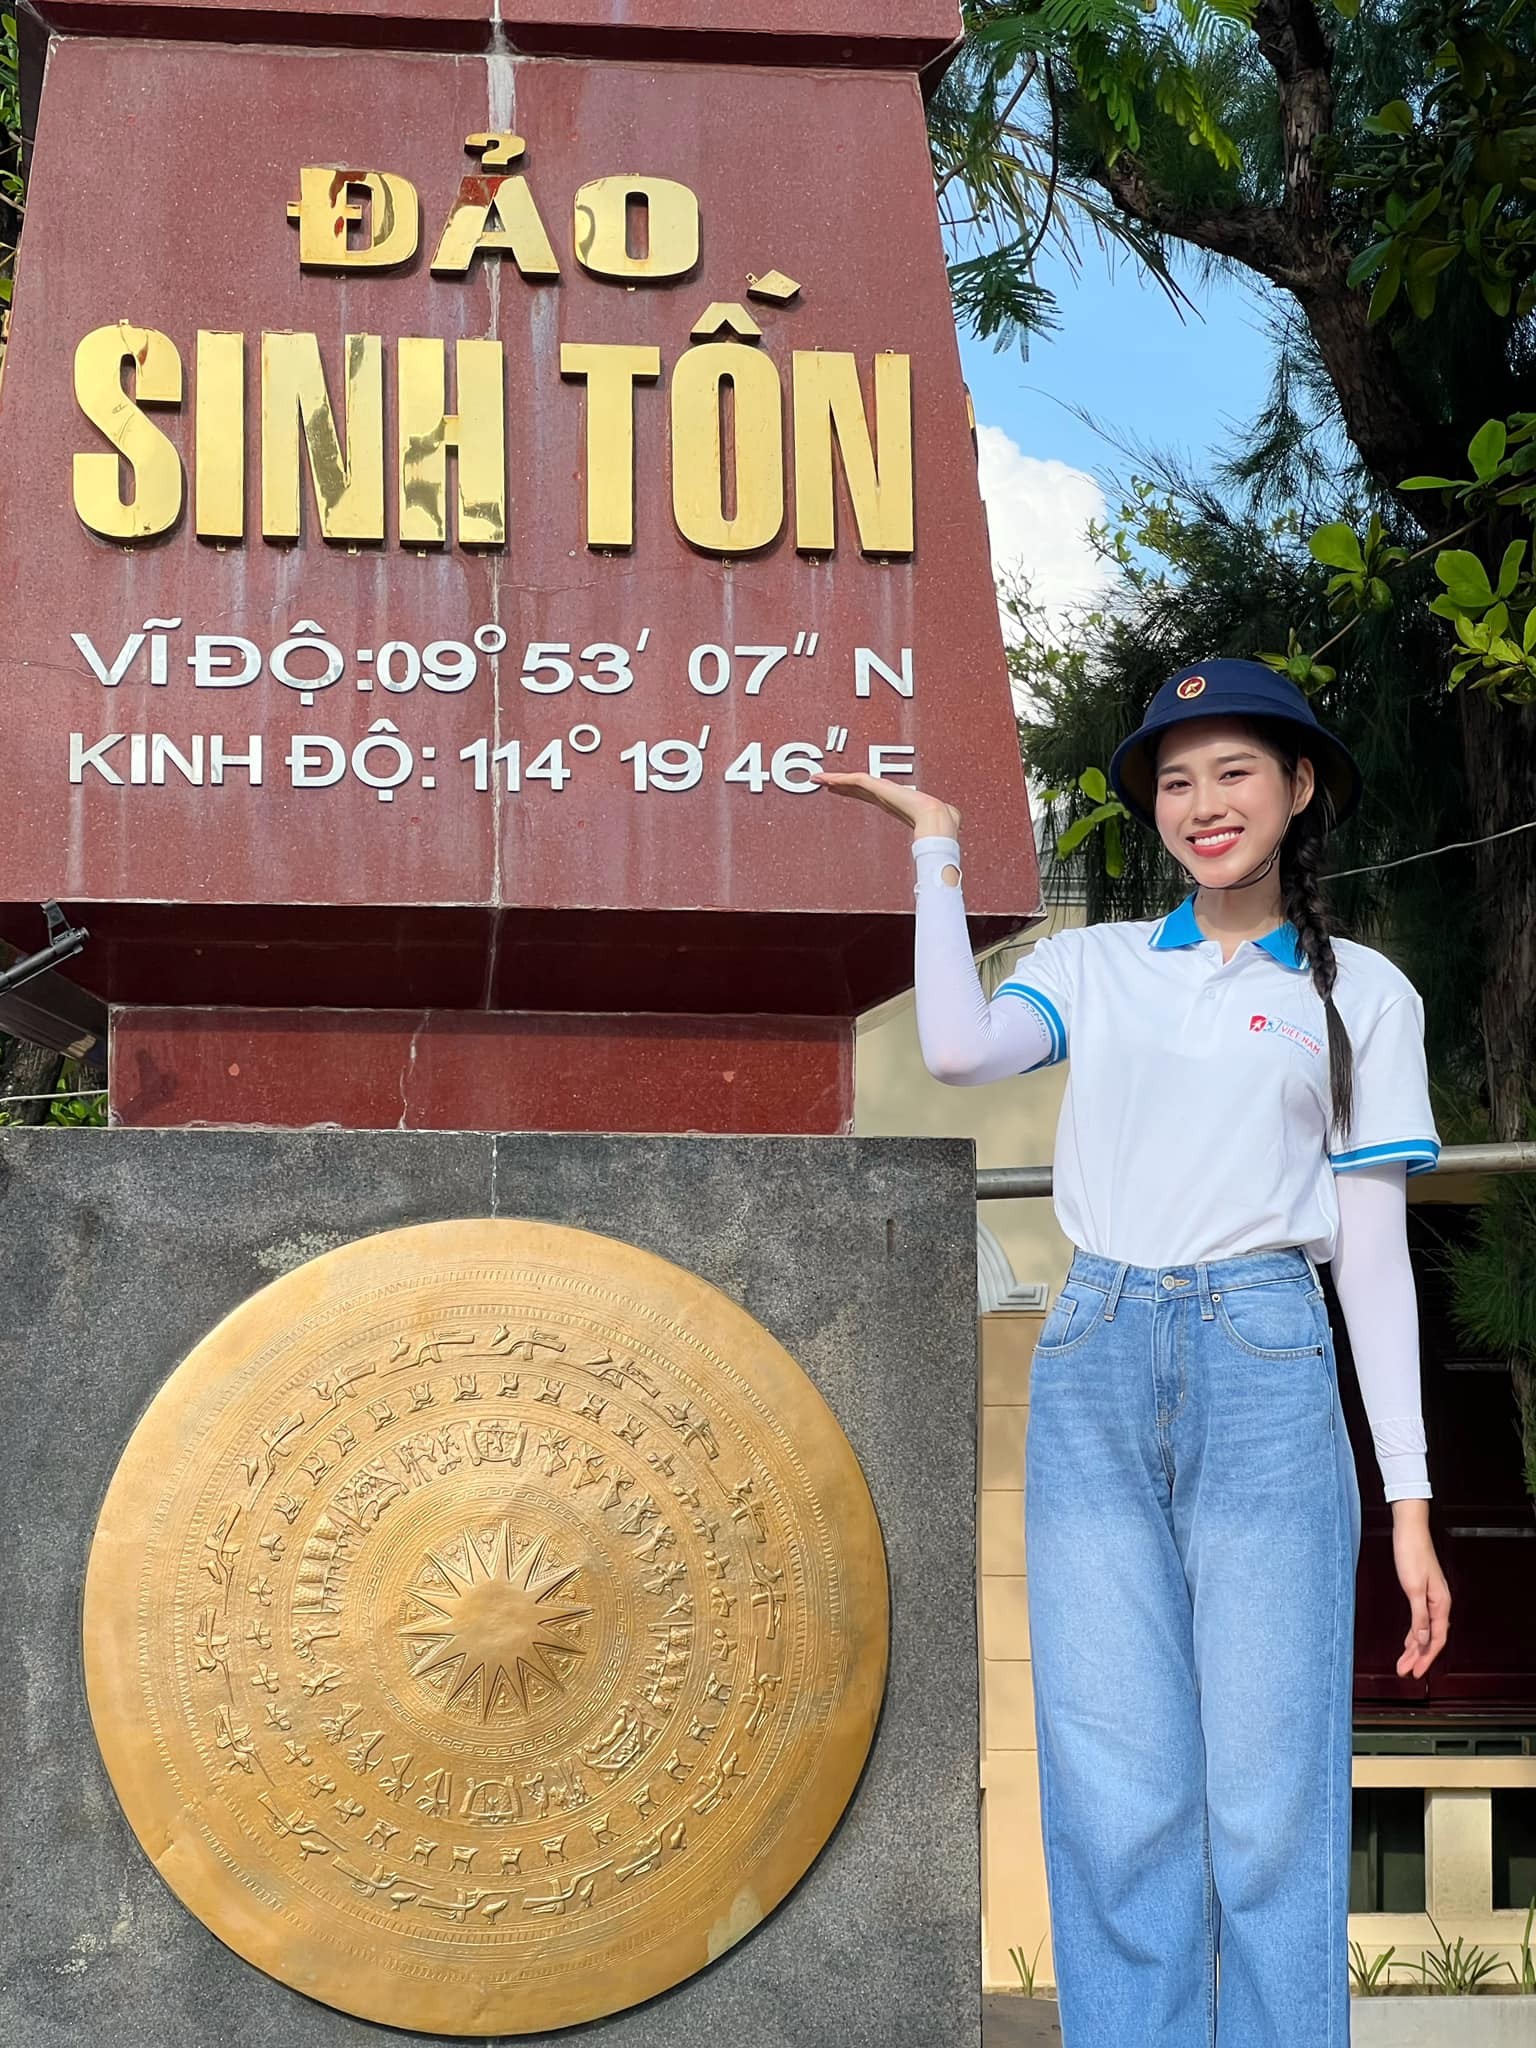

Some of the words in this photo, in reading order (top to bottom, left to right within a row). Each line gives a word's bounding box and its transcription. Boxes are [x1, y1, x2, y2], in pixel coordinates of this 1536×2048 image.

[287, 132, 701, 280] ĐẢO
[72, 320, 507, 543] SINH
[560, 269, 915, 555] TỒN
[70, 617, 182, 686] VĨ
[854, 647, 914, 697] N
[69, 732, 262, 785] KINH
[285, 718, 436, 802] ĐỘ:
[867, 745, 916, 791] E
